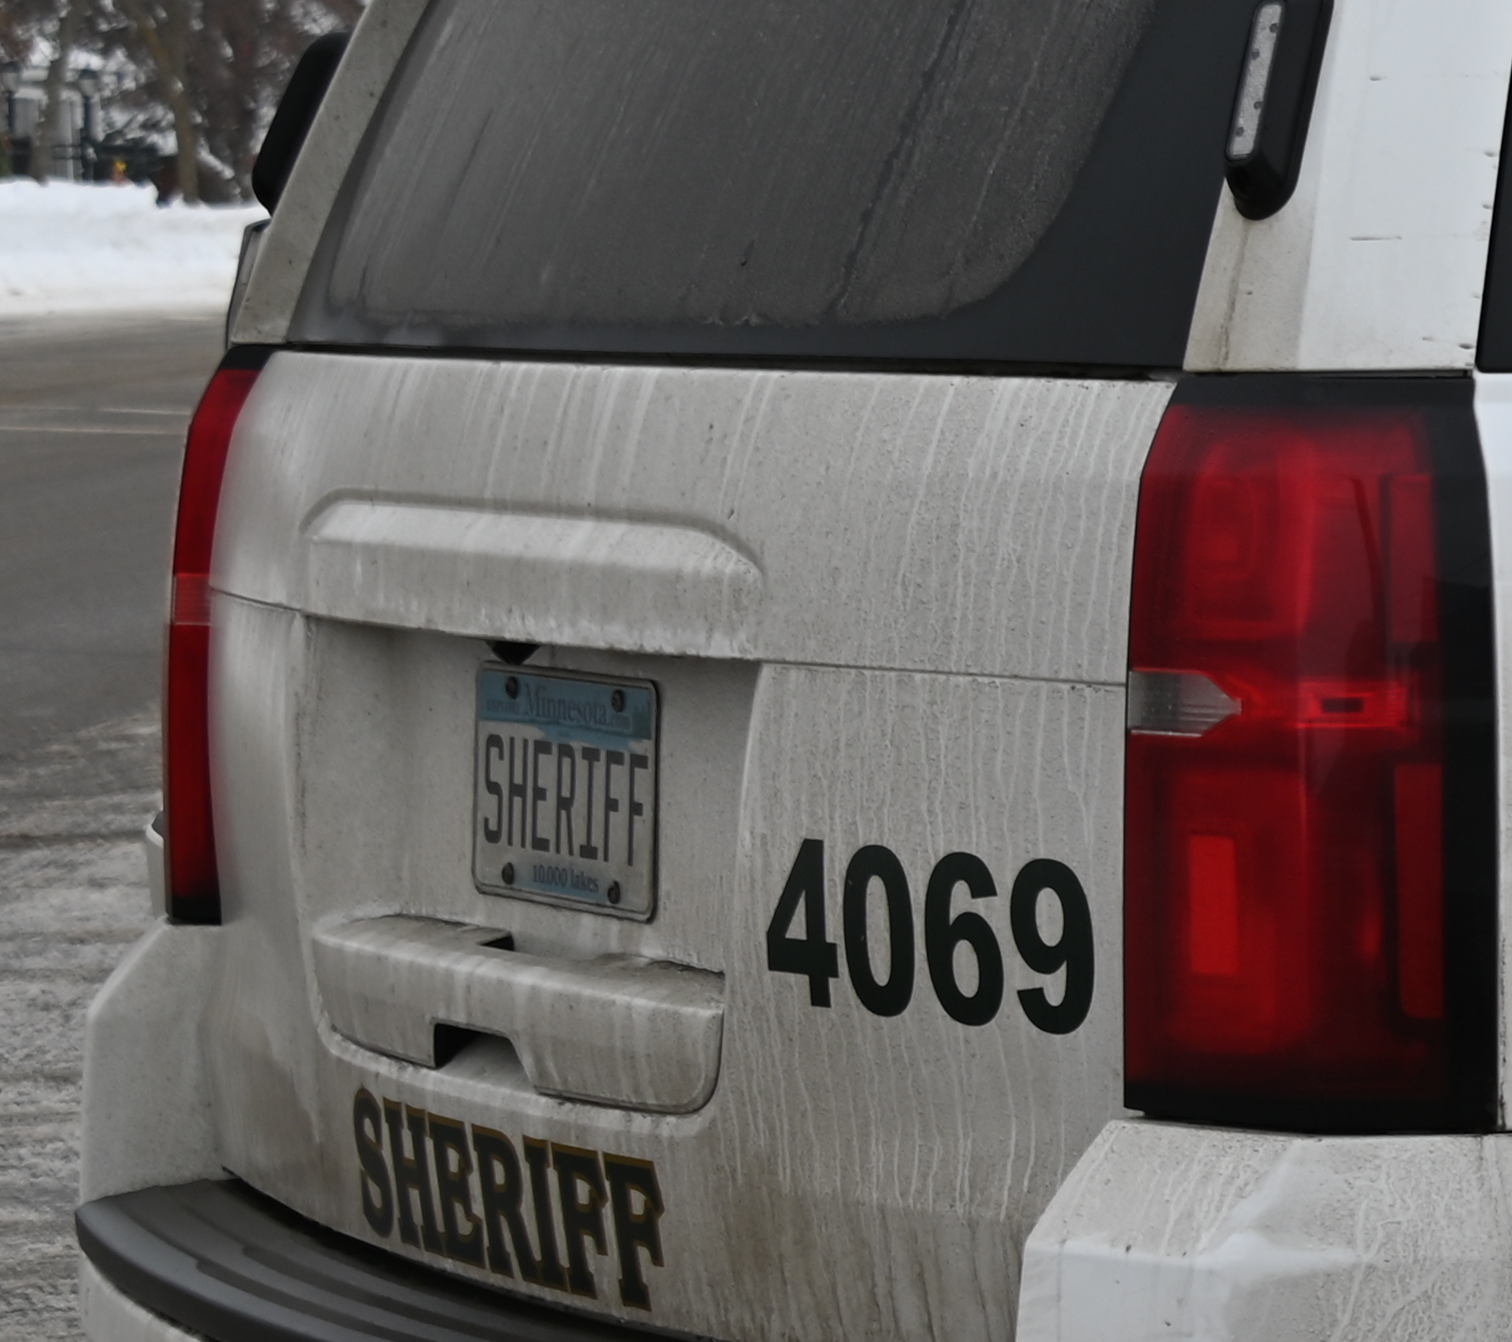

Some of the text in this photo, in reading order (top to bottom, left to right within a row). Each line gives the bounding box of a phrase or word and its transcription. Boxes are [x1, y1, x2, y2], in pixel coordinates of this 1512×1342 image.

[483, 734, 649, 867] SHERIFF
[766, 838, 1095, 1036] 4069
[353, 1086, 665, 1312] SHERIFF
